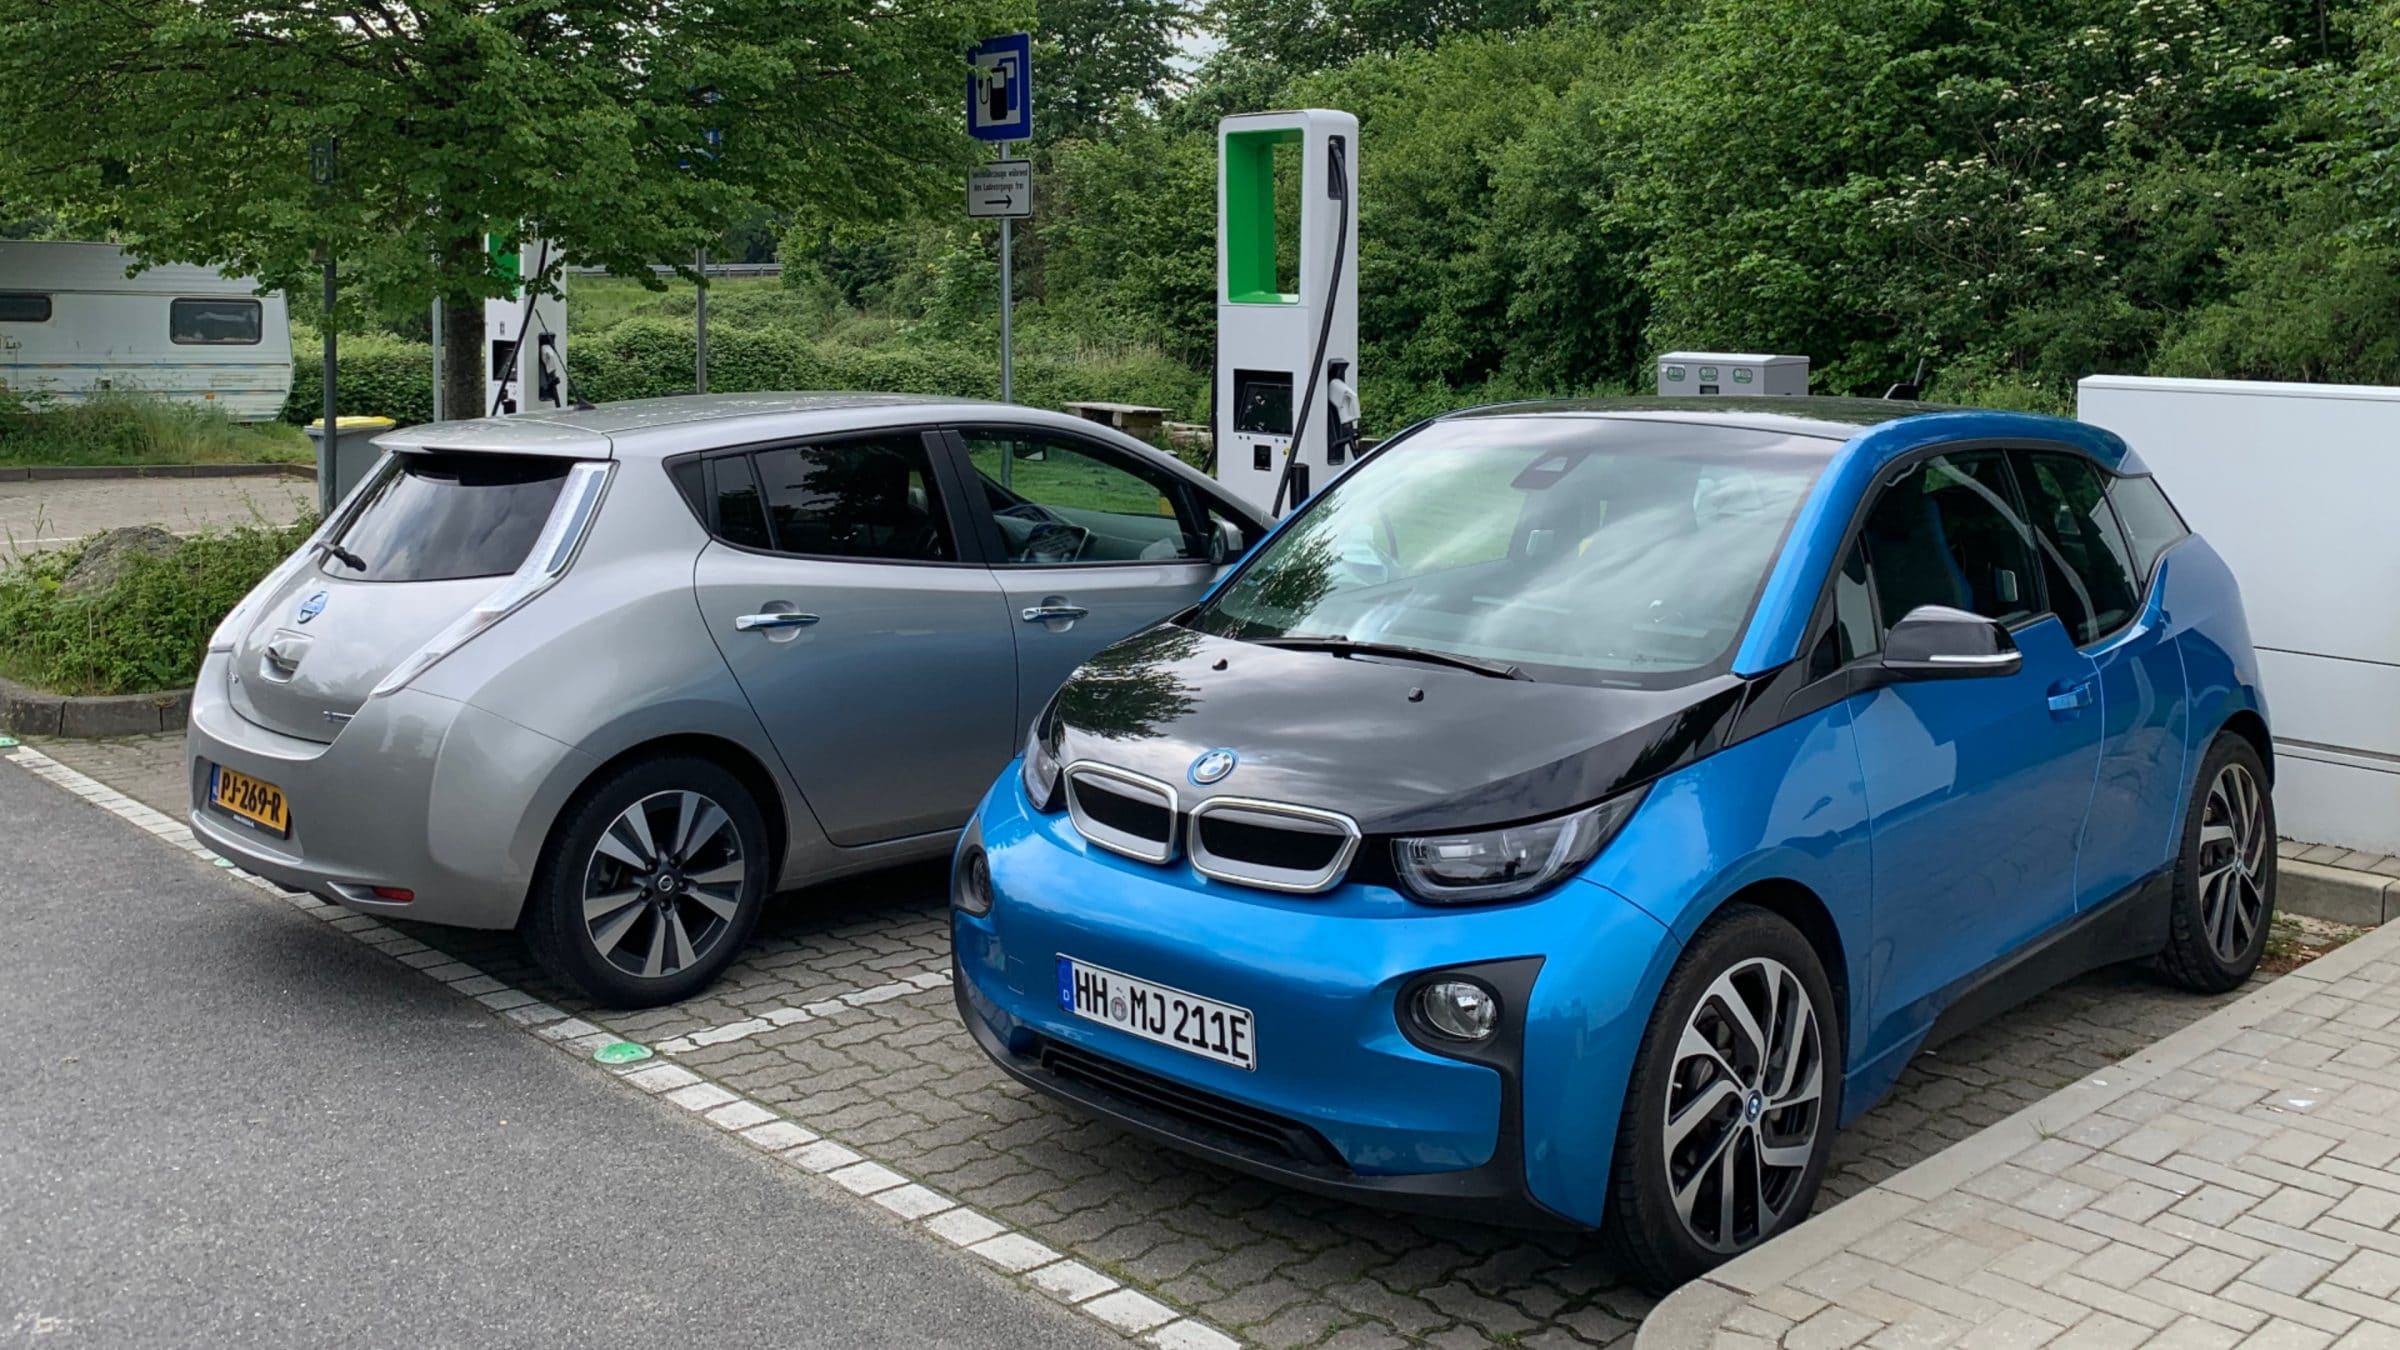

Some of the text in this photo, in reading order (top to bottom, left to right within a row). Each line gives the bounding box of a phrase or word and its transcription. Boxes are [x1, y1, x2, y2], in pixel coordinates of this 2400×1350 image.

[221, 772, 281, 823] PJ-269-R
[1063, 989, 1070, 1002] D
[1075, 968, 1250, 1061] HH MJ 211E
